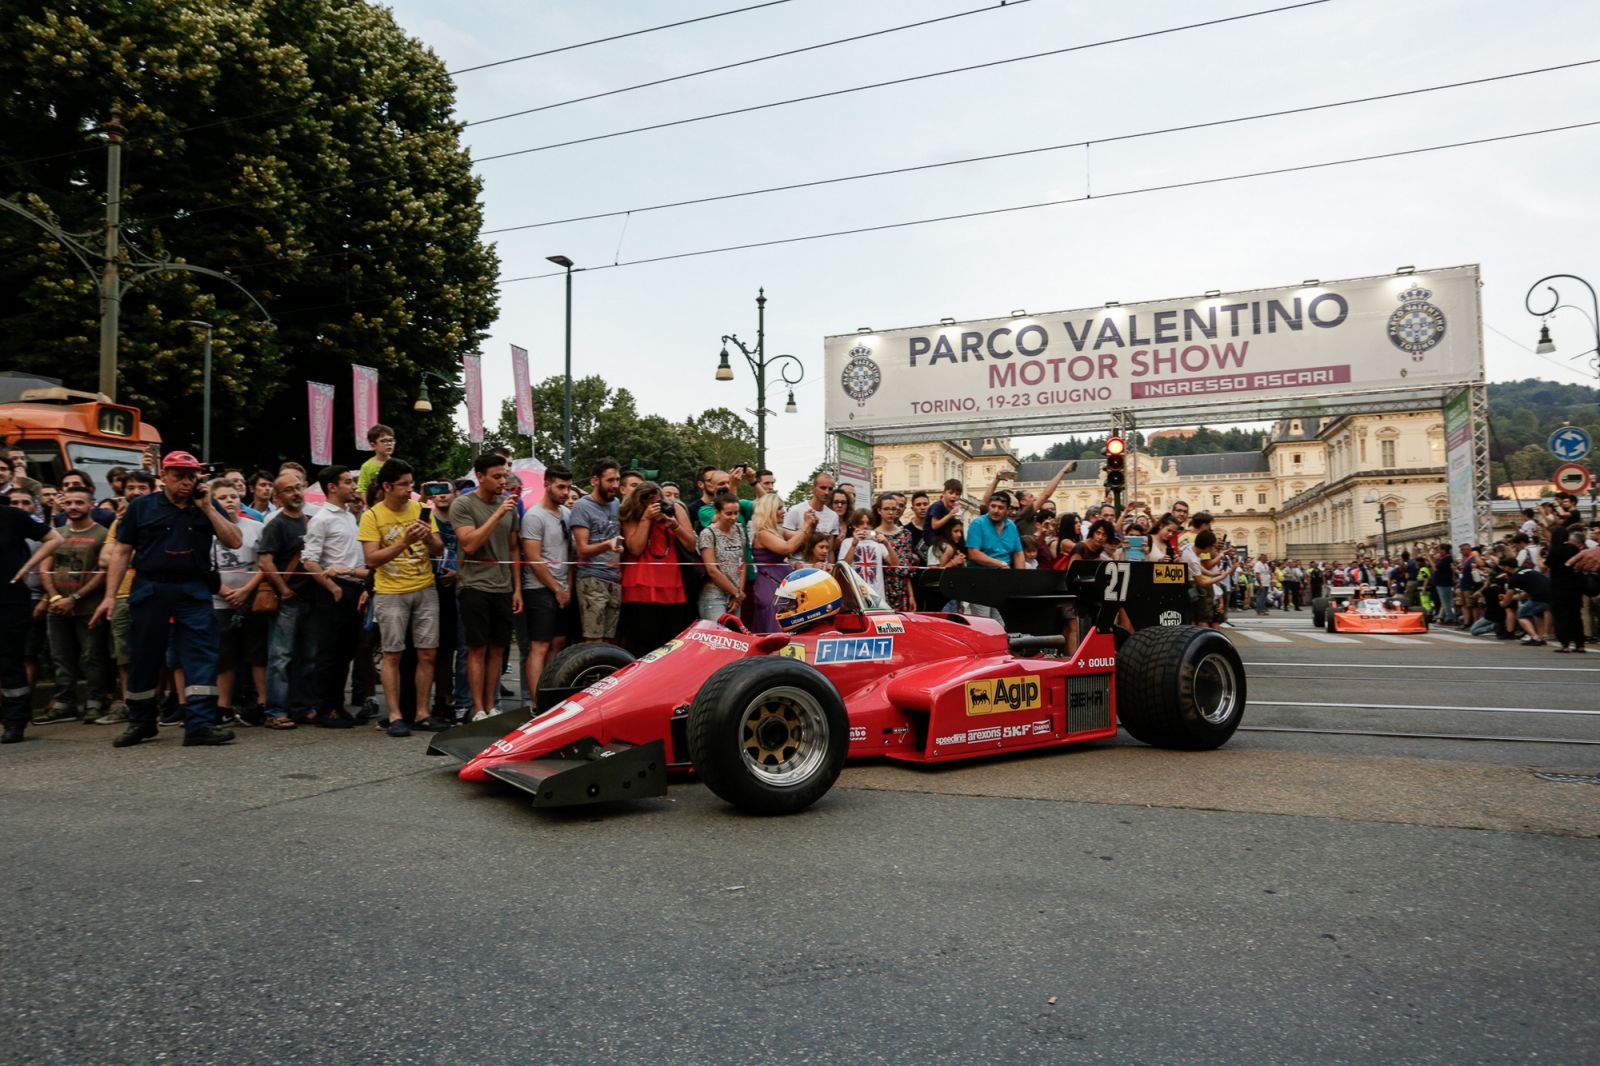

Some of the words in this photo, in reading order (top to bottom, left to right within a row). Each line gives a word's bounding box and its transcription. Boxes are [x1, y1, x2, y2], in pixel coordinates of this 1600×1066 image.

[909, 324, 1049, 367] PARCO
[1064, 293, 1349, 351] VALENTINO
[1390, 310, 1404, 336] PARCO
[1406, 303, 1444, 332] VALENTINO
[1401, 339, 1436, 350] TORINO
[988, 353, 1119, 389] MOTOR
[1130, 340, 1250, 377] SHOW
[1145, 377, 1247, 396] INGRESSO
[1254, 369, 1334, 388] ASCARI
[911, 397, 981, 415] TORINO,
[987, 392, 1031, 410] 19-23
[1036, 386, 1112, 405] GIUGNO
[102, 413, 125, 434] 16
[1104, 561, 1131, 602] 27
[1164, 565, 1183, 581] Agip
[877, 623, 903, 633] Marlboro
[684, 632, 749, 653] LONGINES
[822, 641, 889, 659] FIAT
[1088, 657, 1115, 668] GOULD
[993, 677, 1039, 710] Agip
[935, 733, 967, 746] speedline
[967, 727, 1001, 742] arexons
[1003, 724, 1032, 738] SKF
